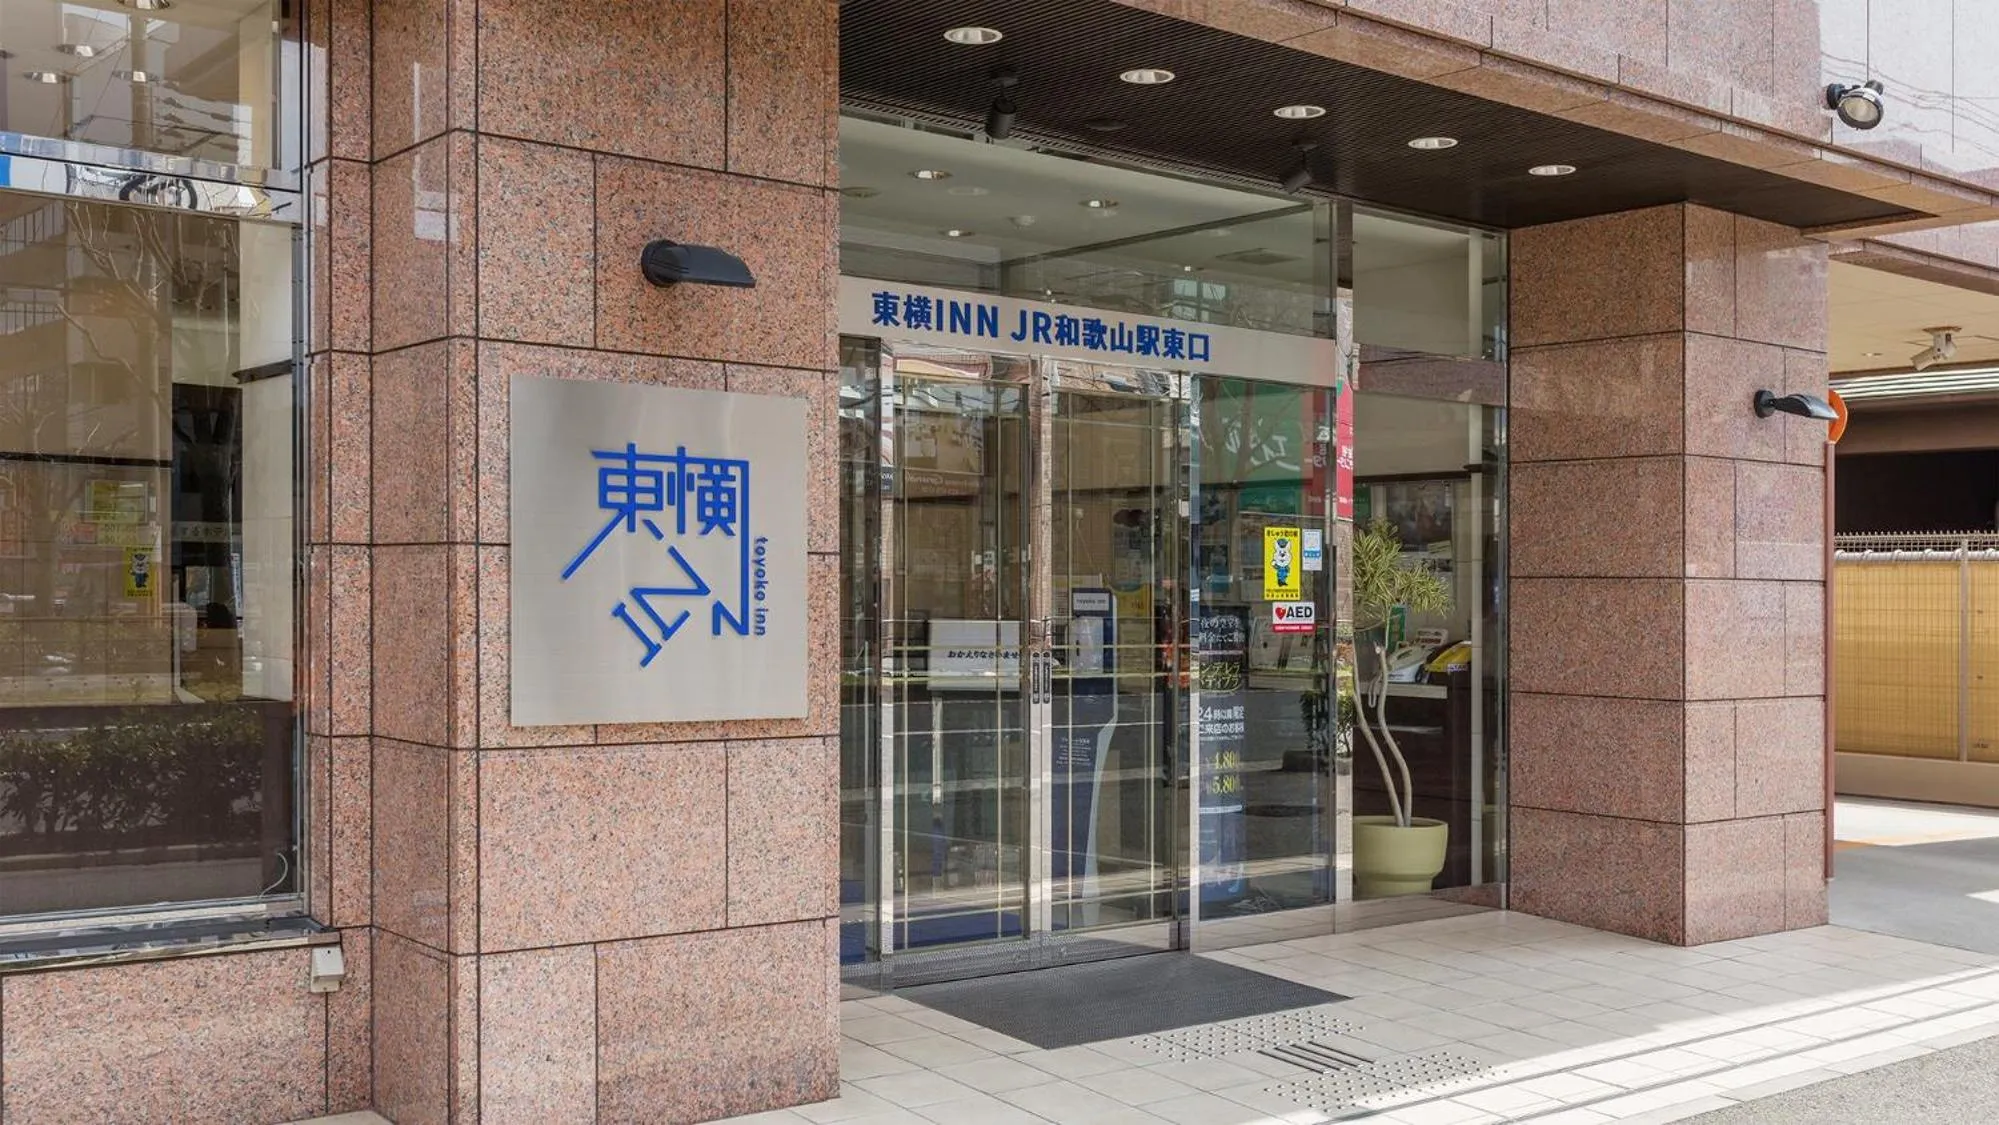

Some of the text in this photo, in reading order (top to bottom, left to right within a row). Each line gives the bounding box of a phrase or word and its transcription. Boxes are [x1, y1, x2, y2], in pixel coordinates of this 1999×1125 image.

[871, 290, 1211, 362] 東横INN JR和歌山駅東口
[752, 536, 769, 636] toyoko inn
[1286, 605, 1313, 618] AED
